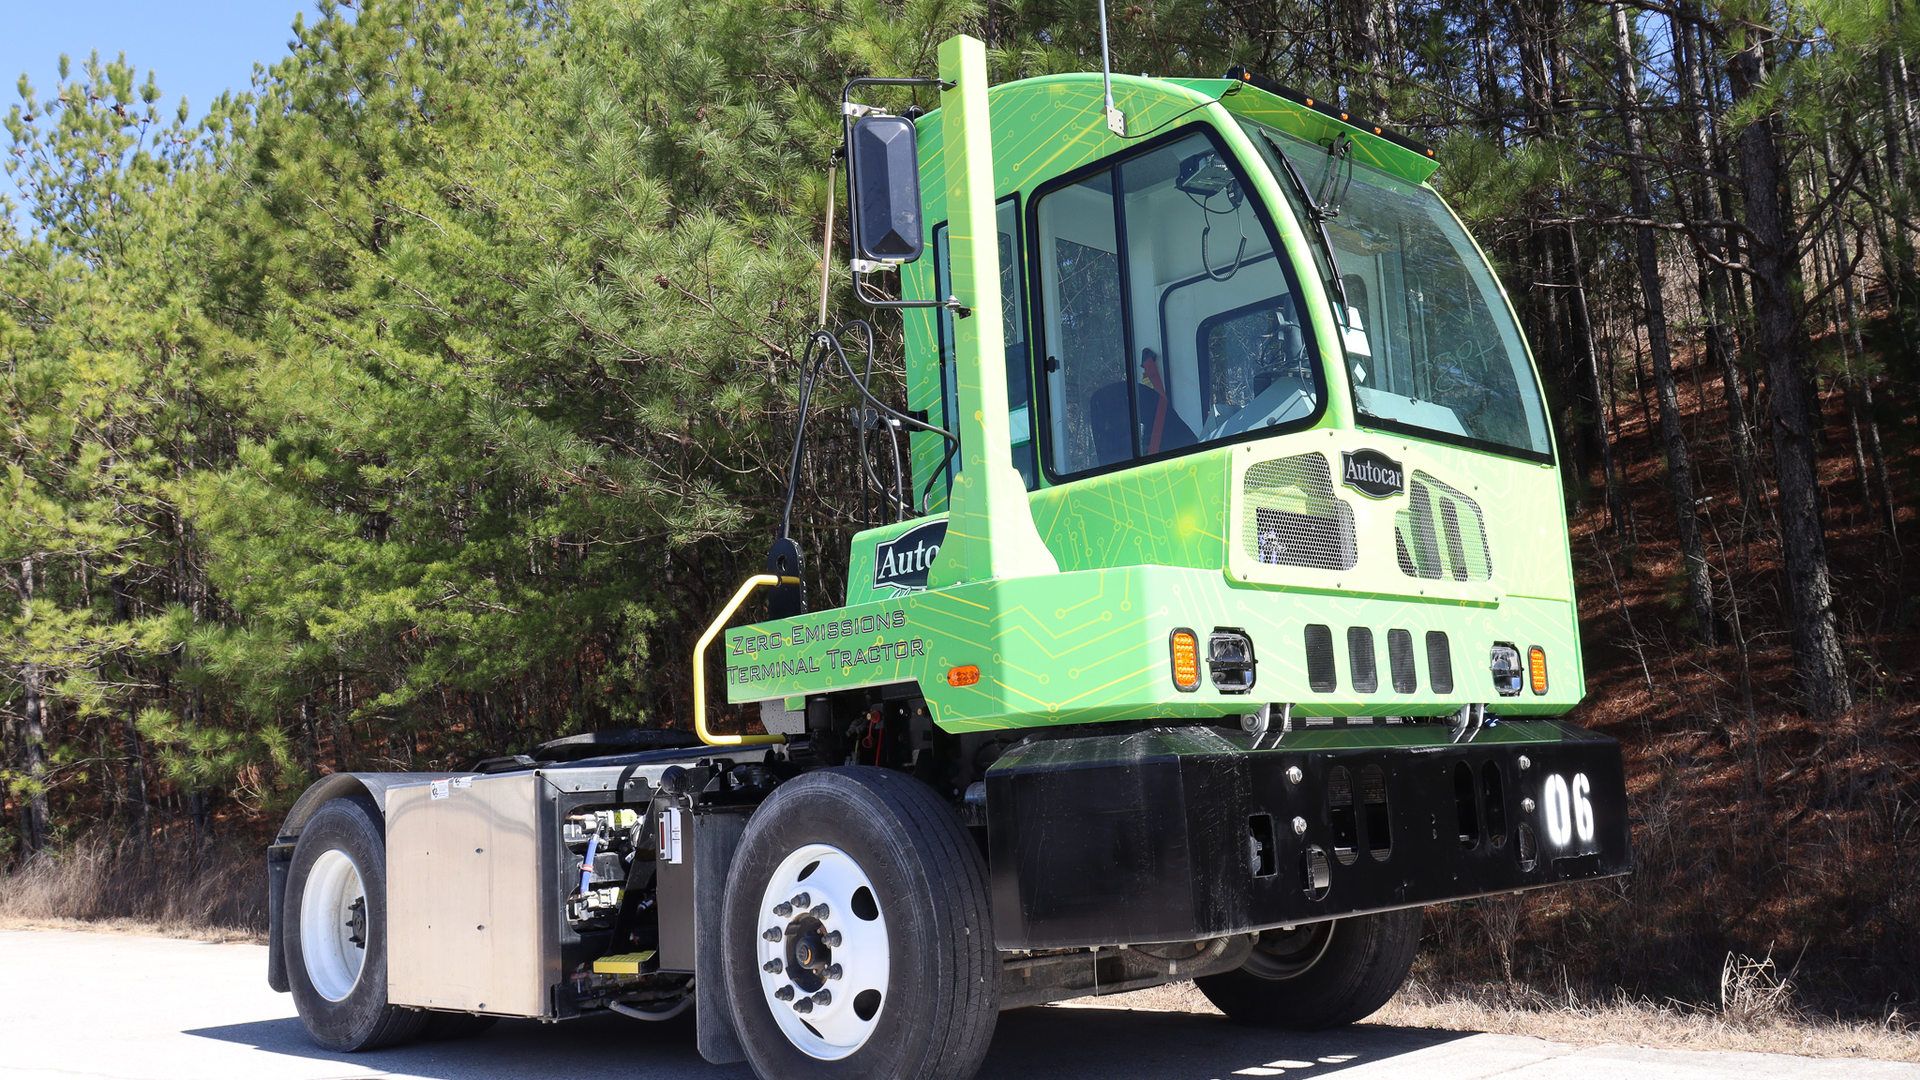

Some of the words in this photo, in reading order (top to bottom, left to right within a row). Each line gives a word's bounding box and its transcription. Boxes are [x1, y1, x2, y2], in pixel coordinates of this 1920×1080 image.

[1345, 456, 1402, 488] Autocar
[732, 632, 782, 656] ZERO
[792, 610, 906, 645] EMISSIONS
[726, 656, 820, 685] TERMINAL
[826, 639, 925, 669] TRACTOR
[1544, 772, 1595, 846] 06
